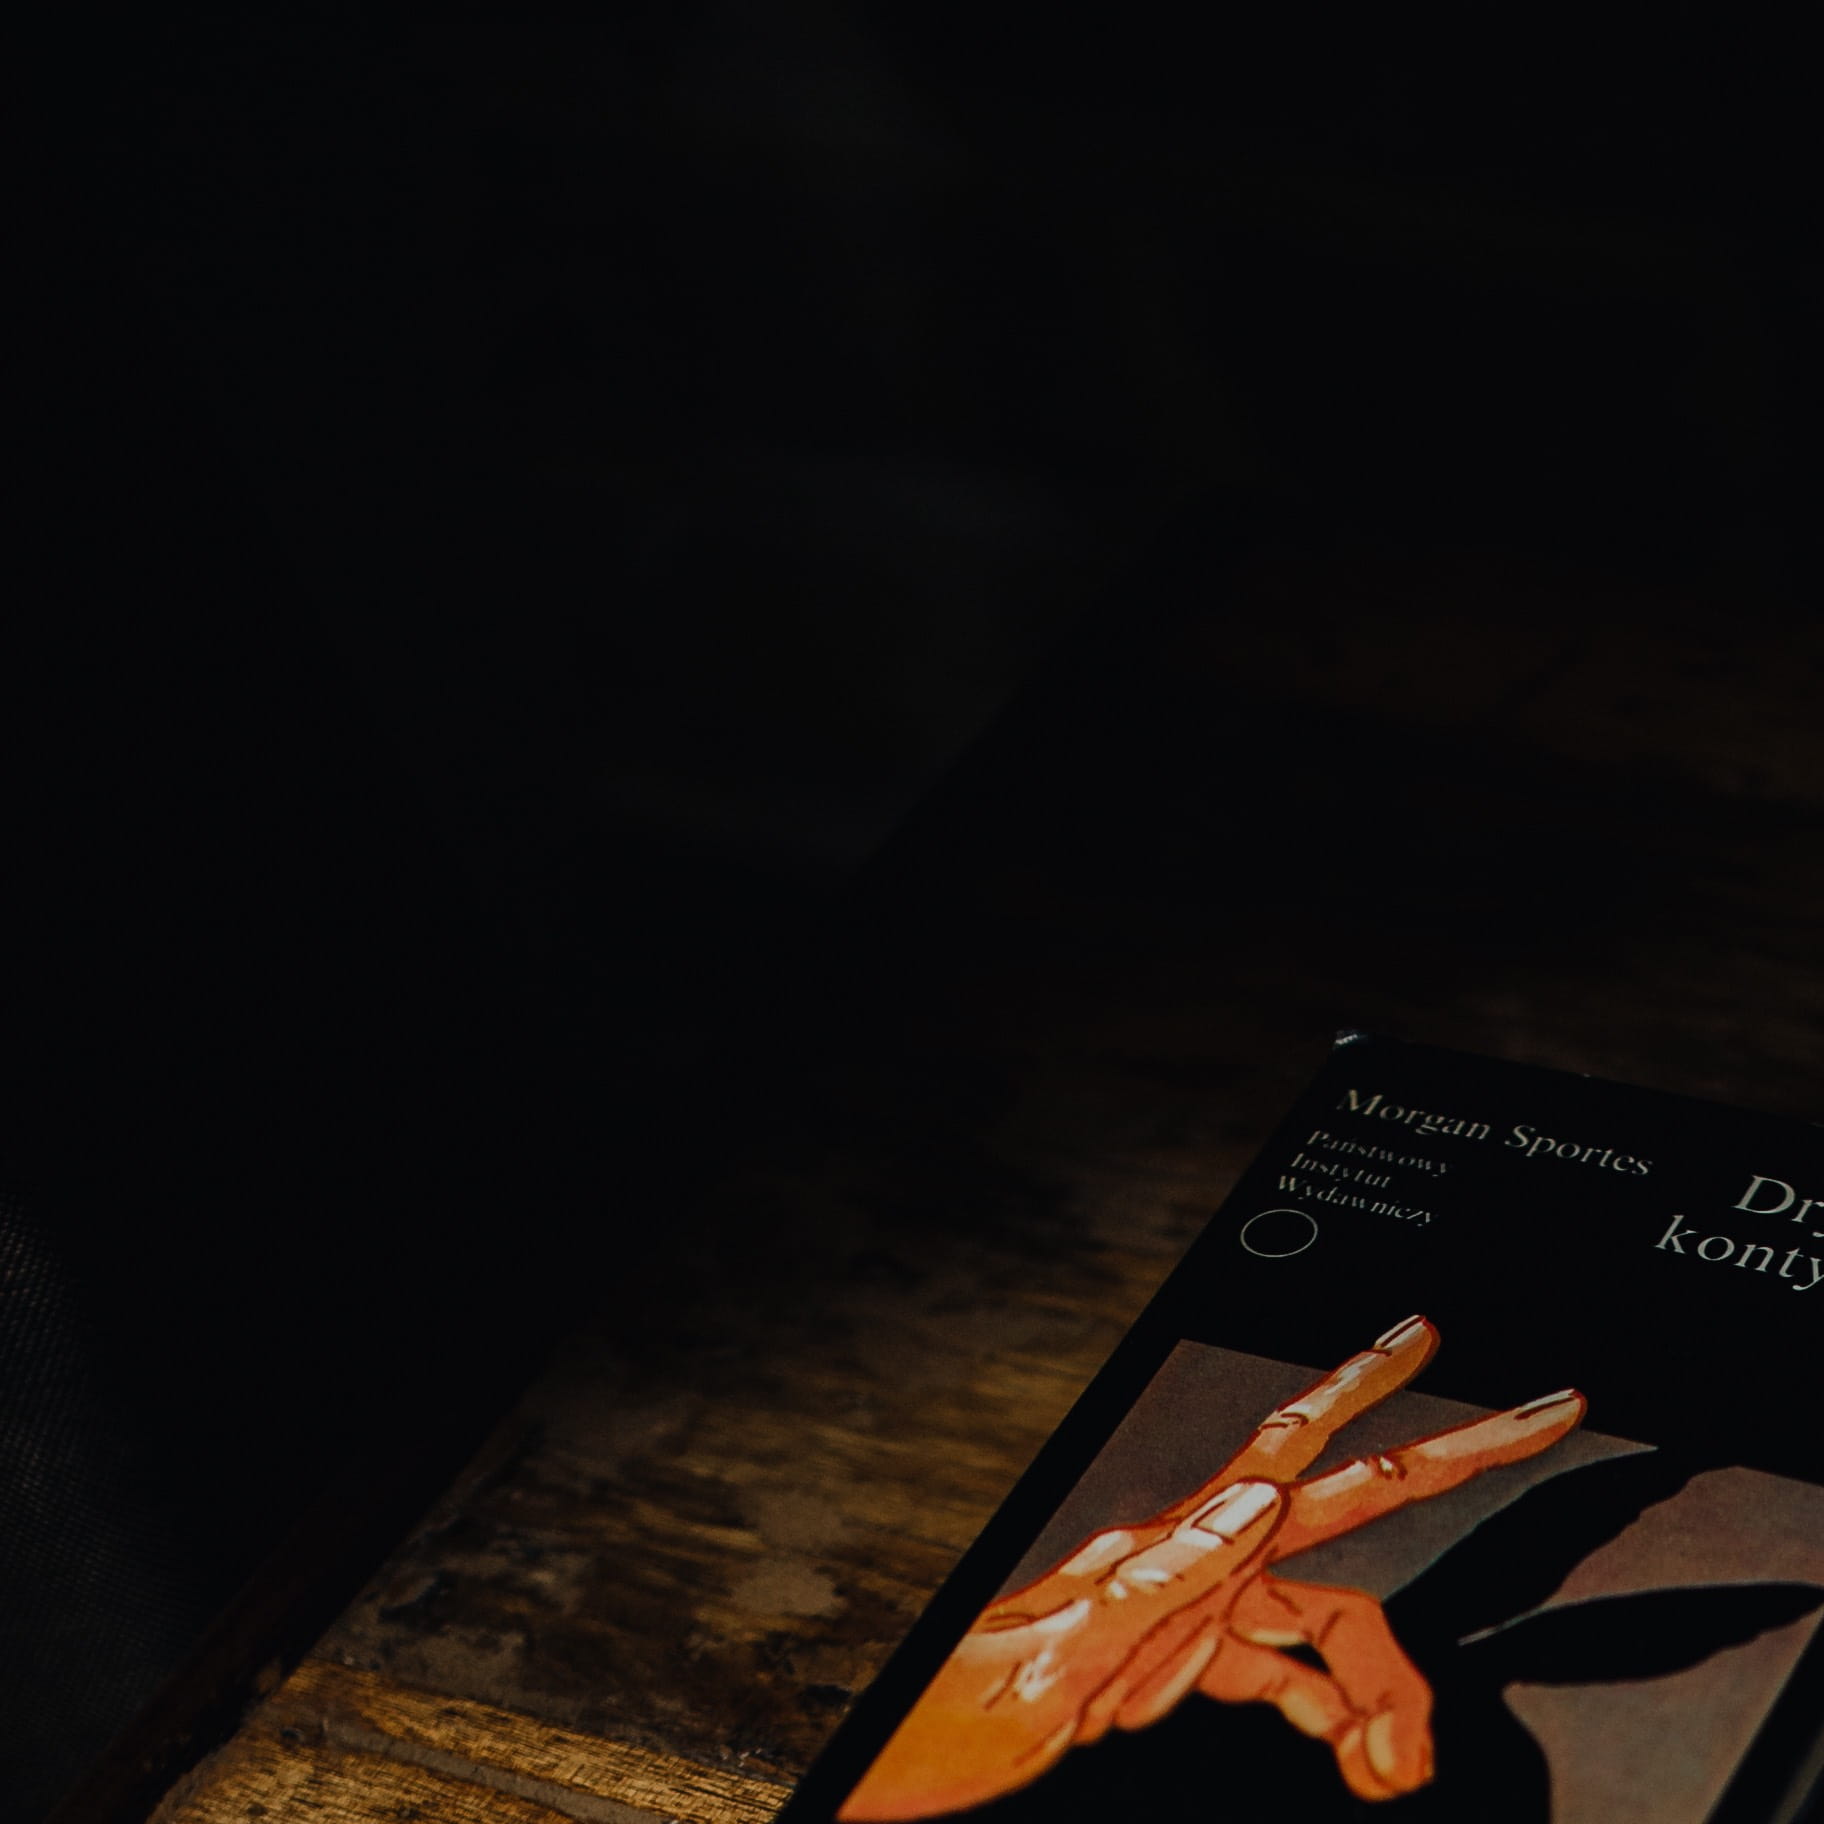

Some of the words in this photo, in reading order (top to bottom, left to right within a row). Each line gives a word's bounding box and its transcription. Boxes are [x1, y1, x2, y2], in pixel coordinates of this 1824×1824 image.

[1337, 1089, 1490, 1141] Morgan
[1505, 1124, 1655, 1176] Sportes
[1290, 1152, 1391, 1189] Instytut
[1277, 1175, 1439, 1226] Wydawniczy
